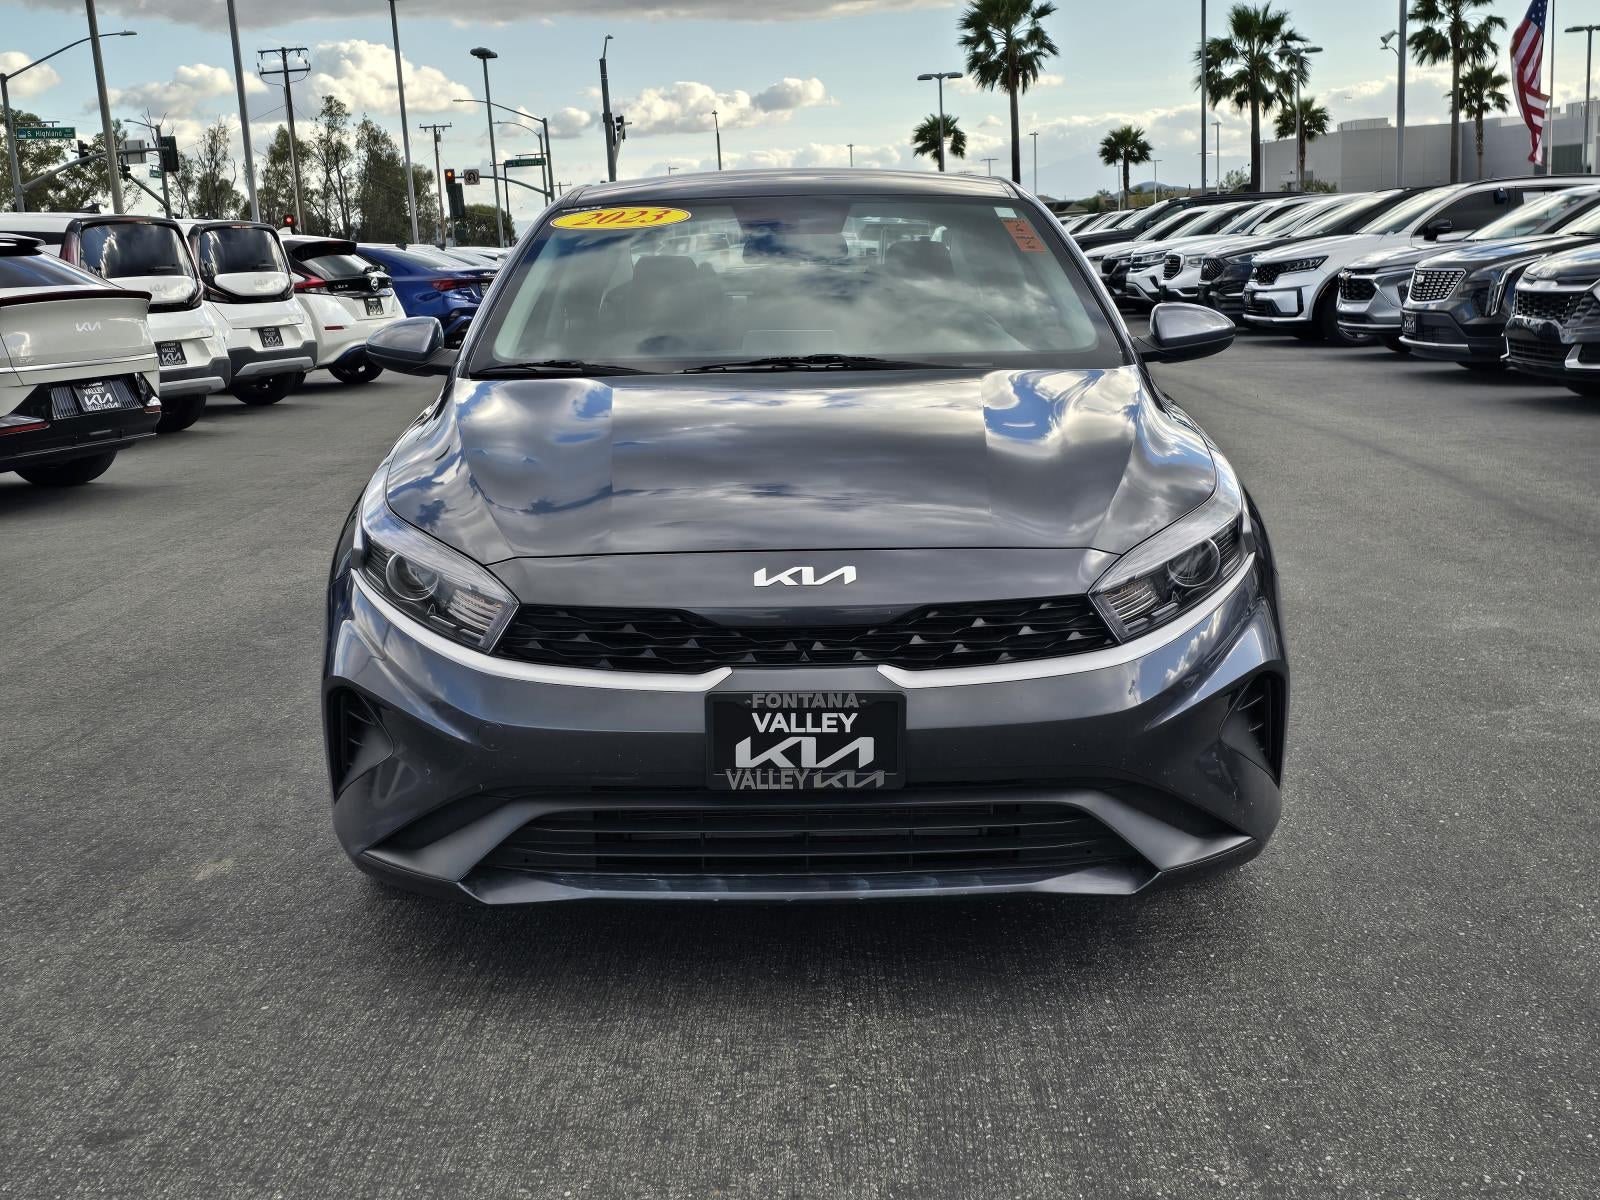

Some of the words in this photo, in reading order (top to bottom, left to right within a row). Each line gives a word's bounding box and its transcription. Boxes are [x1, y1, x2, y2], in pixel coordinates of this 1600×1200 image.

[35, 130, 63, 139] Highland
[572, 210, 671, 226] 2023
[75, 321, 101, 332] KIA
[265, 335, 280, 344] KIA
[161, 352, 182, 361] KIA
[83, 386, 105, 395] VALLEY
[84, 393, 113, 406] KIA
[753, 565, 857, 587] KIA
[752, 692, 860, 709] FONTANA
[752, 712, 859, 733] VALLEY
[735, 735, 875, 769] KIA
[725, 768, 811, 790] VALLEY
[813, 770, 886, 789] KIA
